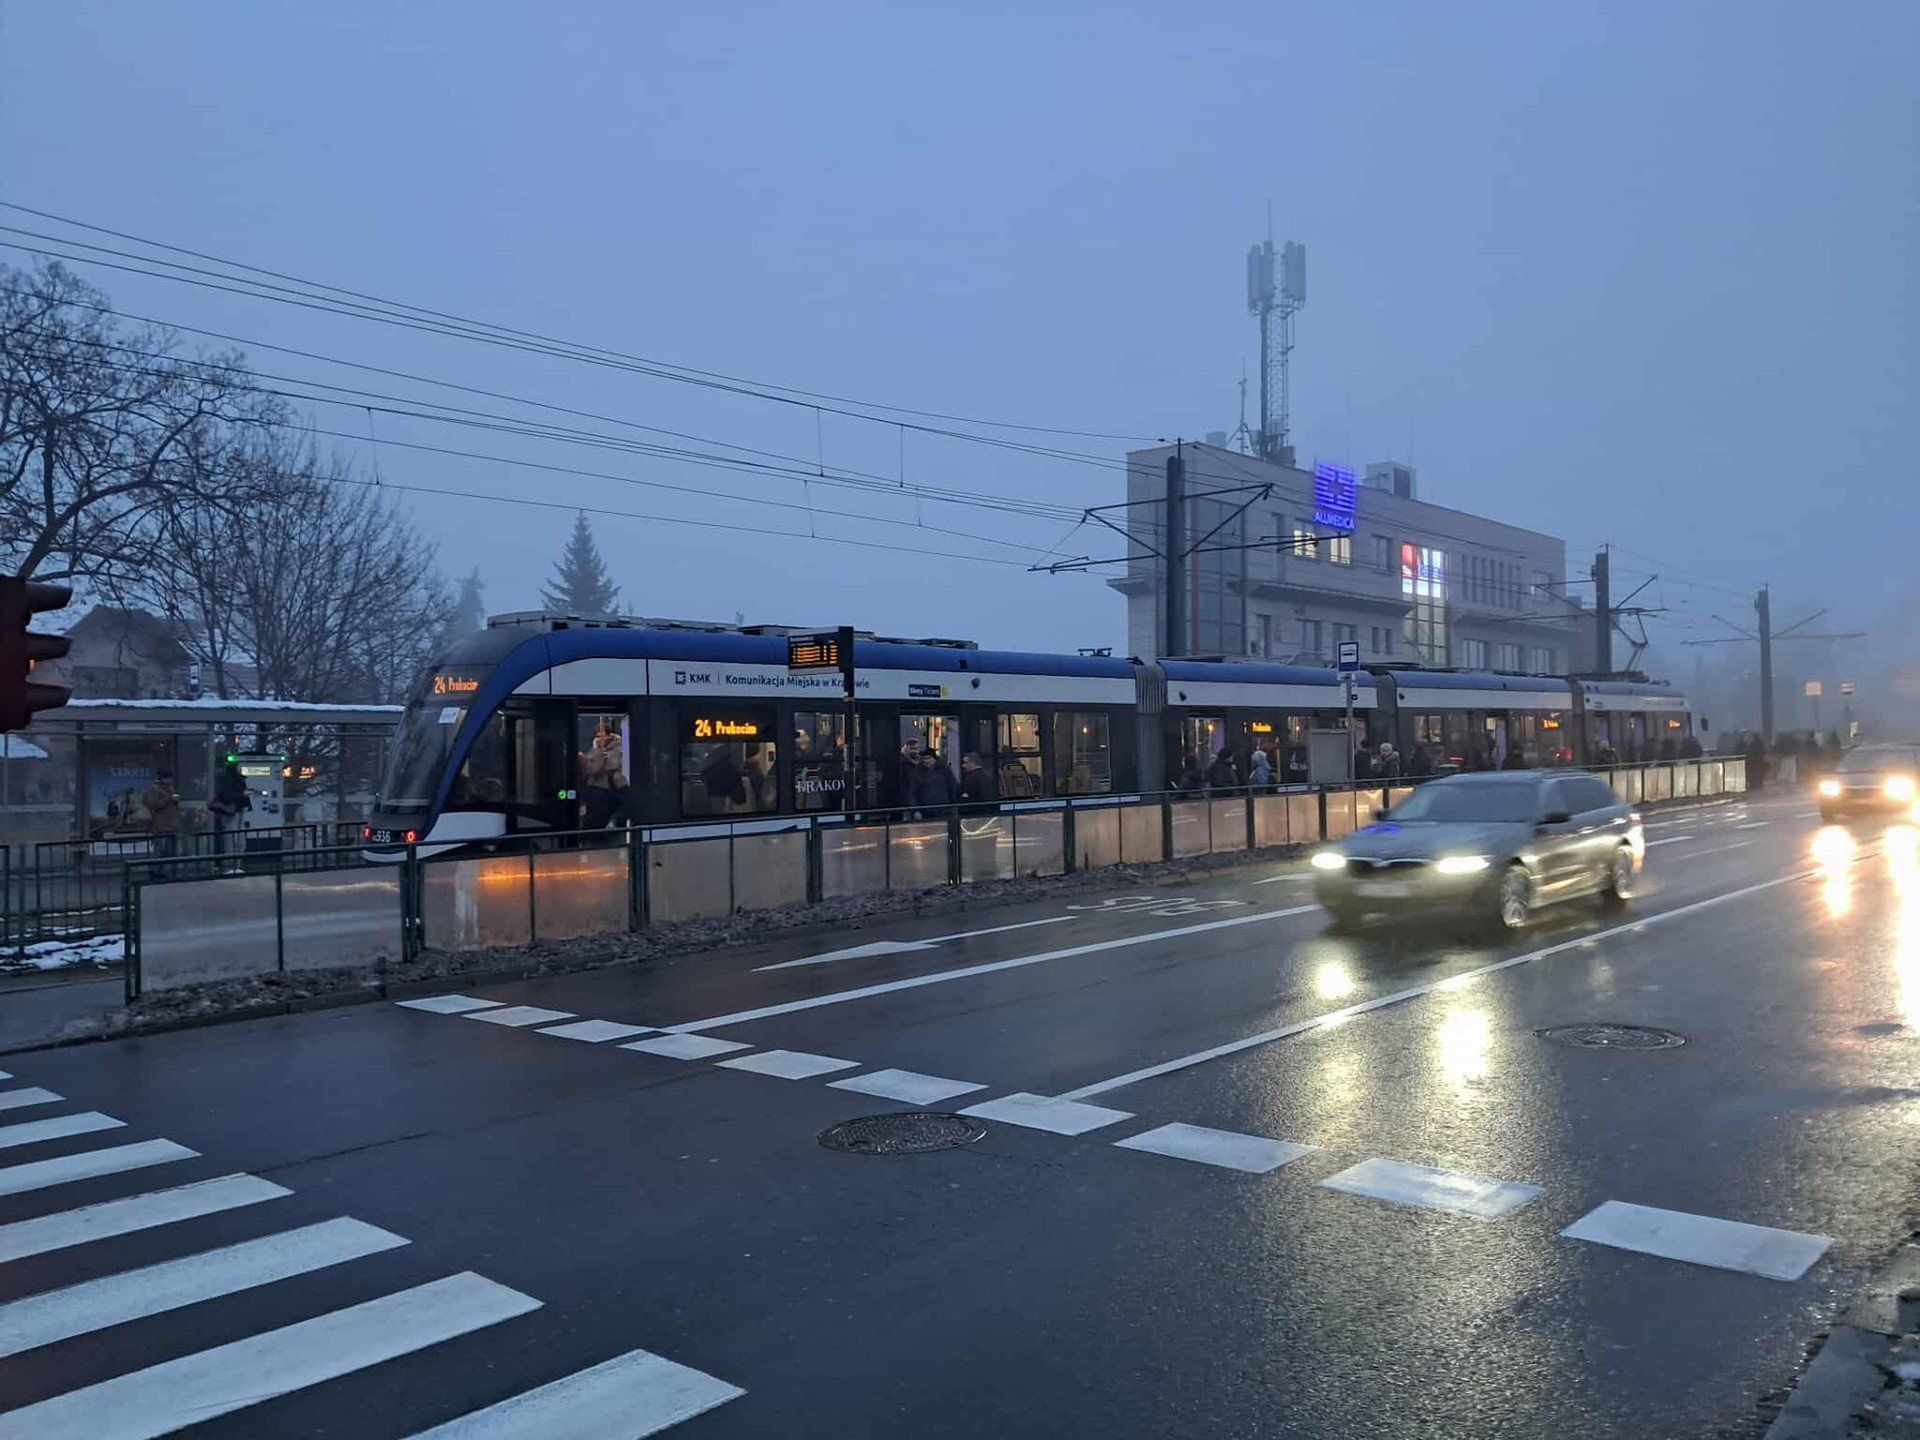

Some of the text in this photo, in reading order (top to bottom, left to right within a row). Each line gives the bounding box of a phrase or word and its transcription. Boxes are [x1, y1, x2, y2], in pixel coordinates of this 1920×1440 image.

[434, 675, 446, 694] 24
[690, 673, 711, 684] KMK
[725, 674, 784, 687] Komunikacja
[786, 676, 820, 688] Miejska
[822, 679, 829, 687] w
[695, 719, 711, 737] 24
